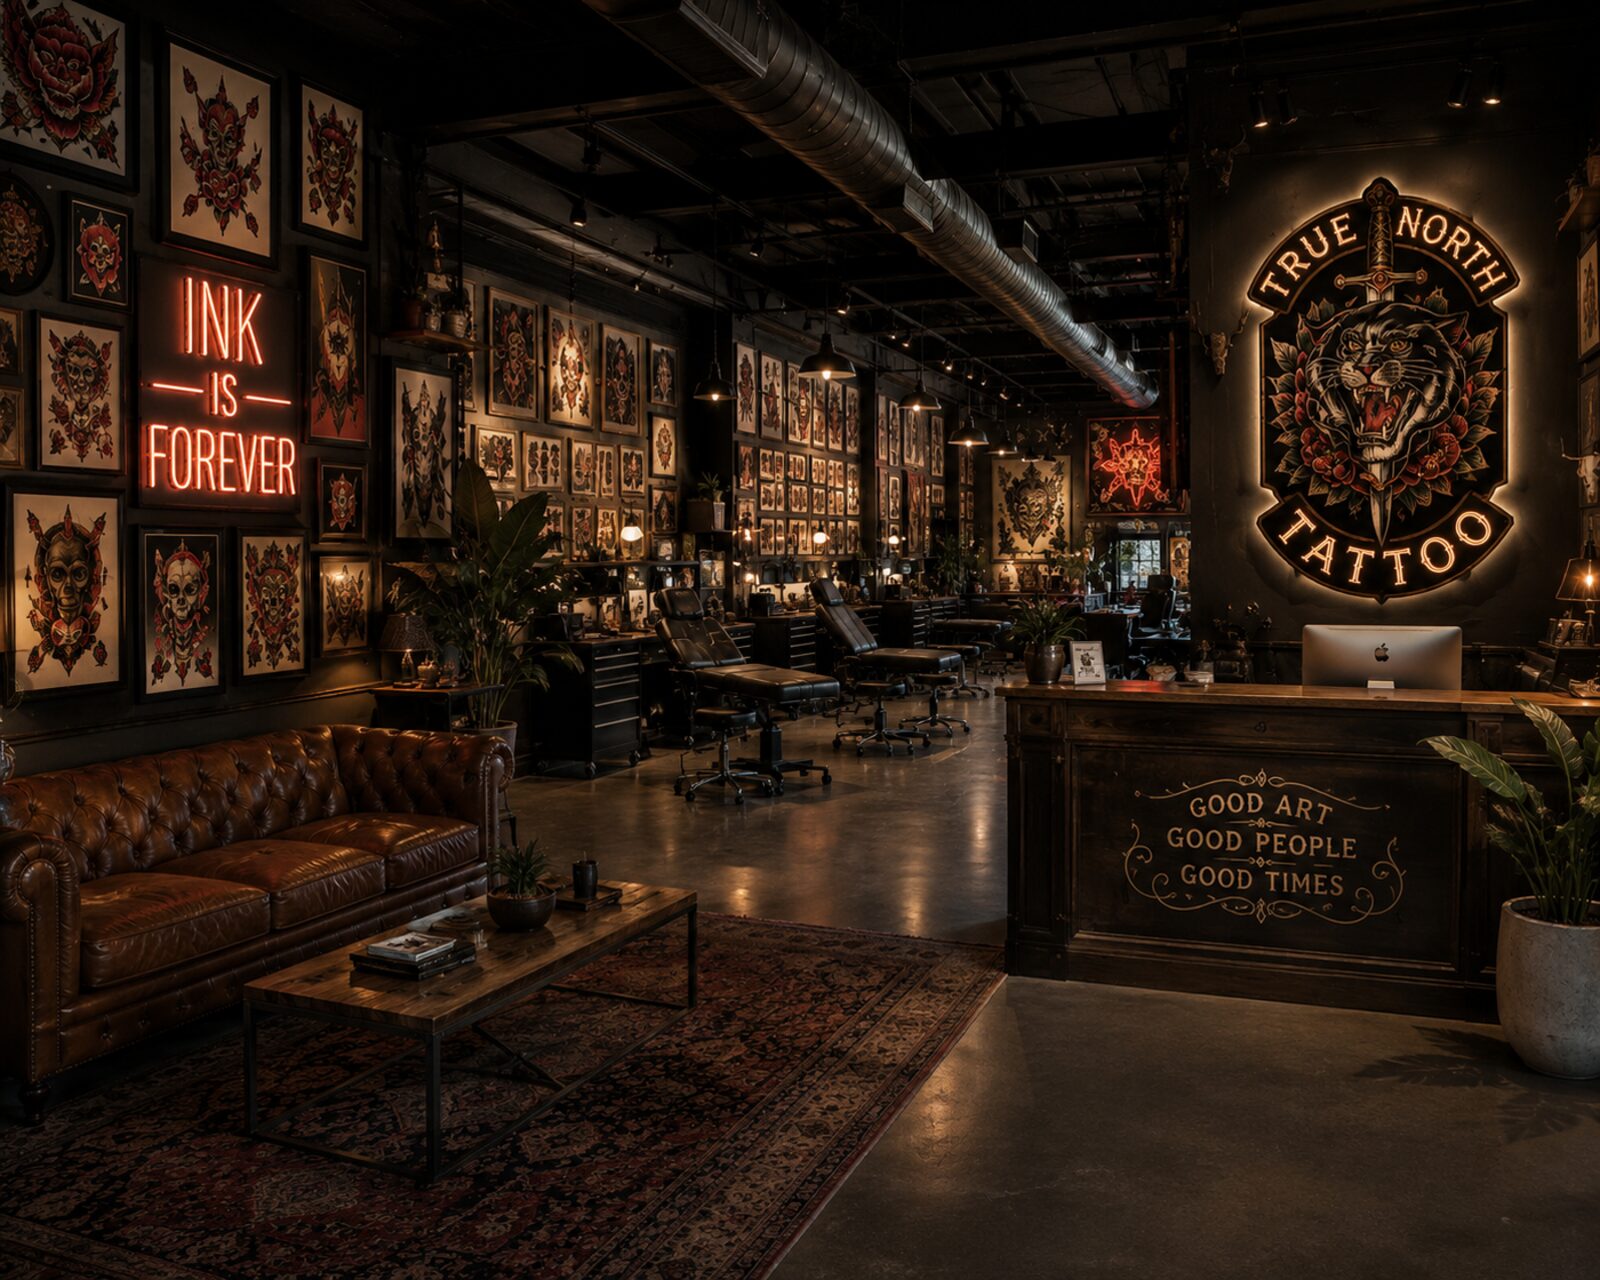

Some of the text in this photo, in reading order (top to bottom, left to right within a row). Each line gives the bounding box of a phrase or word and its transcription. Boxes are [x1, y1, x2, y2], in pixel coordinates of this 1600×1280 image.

[1260, 205, 1508, 297] TRUE NORTH
[184, 277, 263, 365] INK
[211, 372, 238, 417] IS
[148, 424, 296, 495] FOREVER
[1278, 508, 1492, 585] TATTOO
[1189, 792, 1333, 825] GOOD ART
[1167, 827, 1357, 859] GOOD PEOPLE
[1180, 864, 1344, 896] GOOD TIMES
